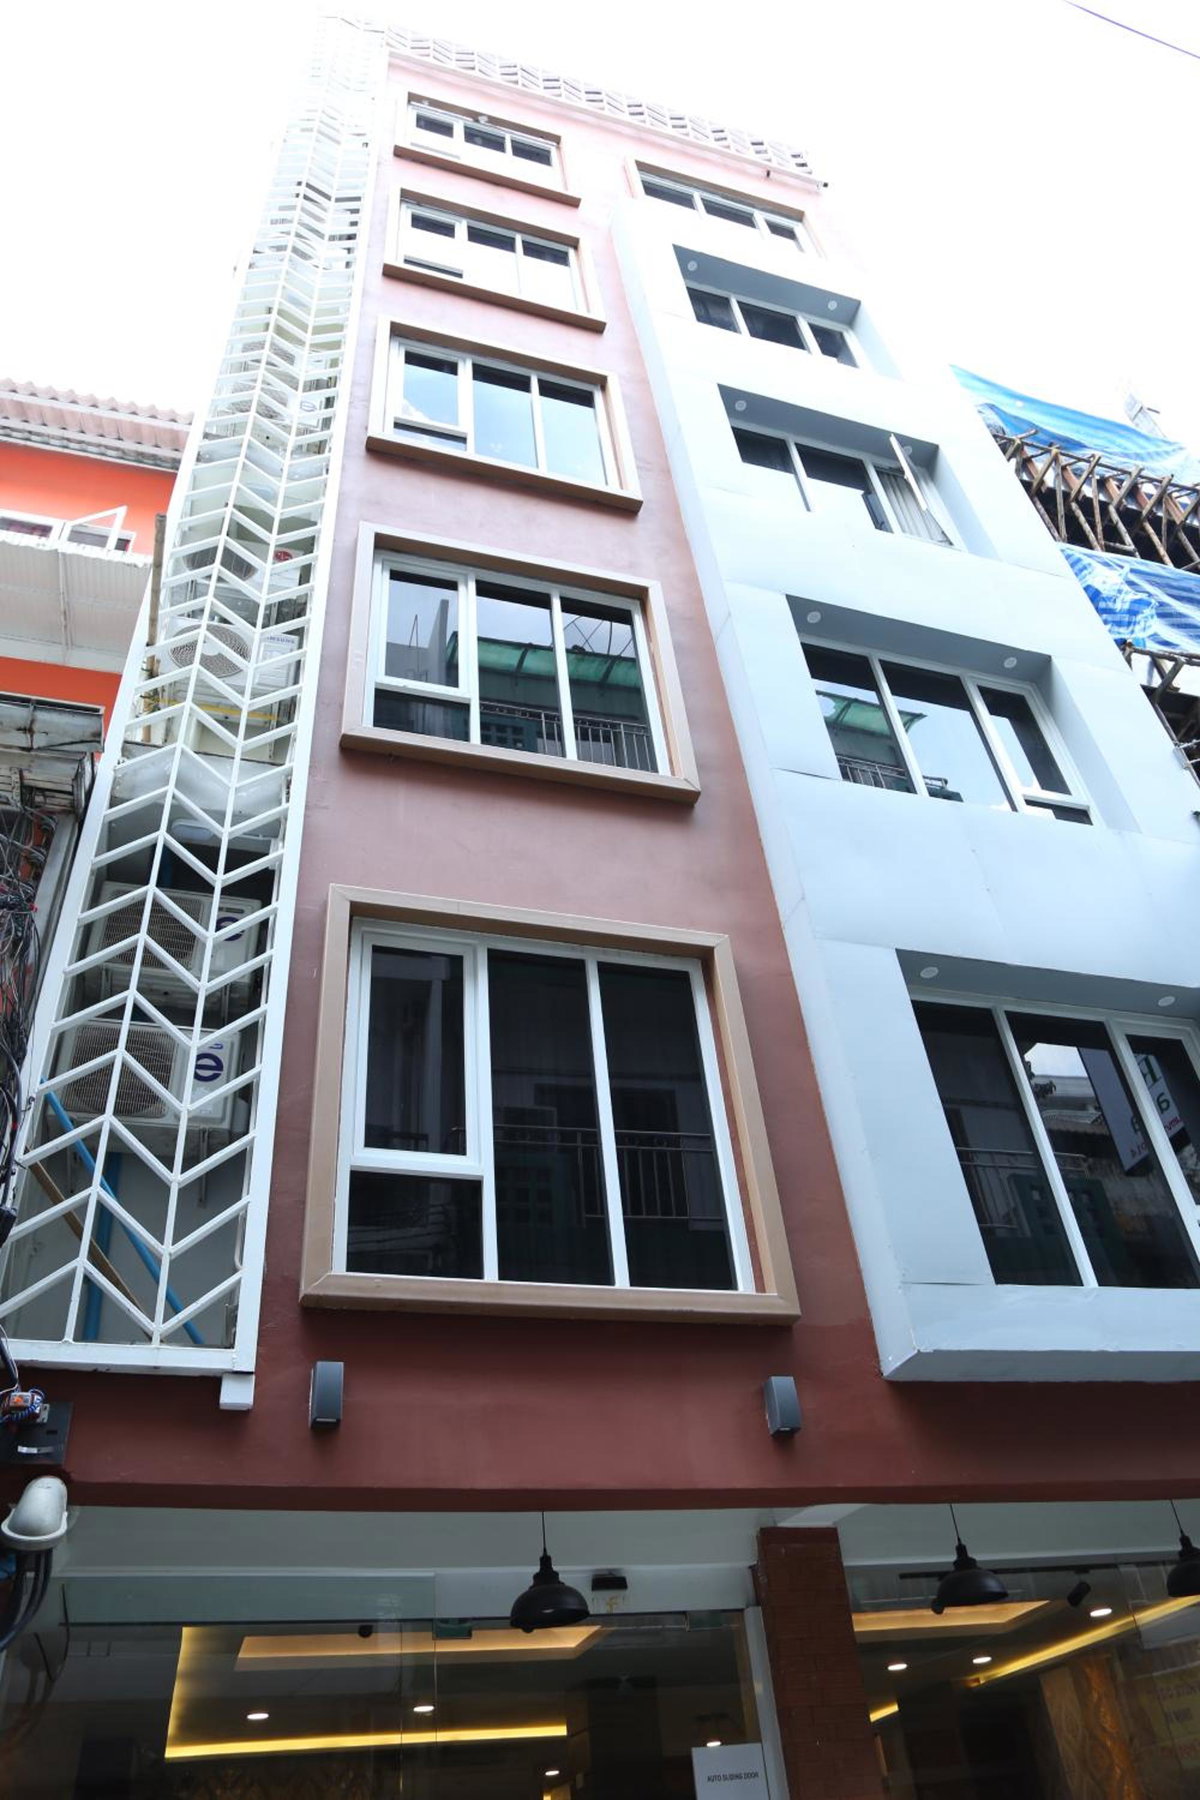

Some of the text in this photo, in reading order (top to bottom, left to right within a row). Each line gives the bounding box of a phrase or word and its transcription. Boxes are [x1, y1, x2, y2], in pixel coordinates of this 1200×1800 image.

[707, 1771, 760, 1783] AUTO SLIDING DOOR
